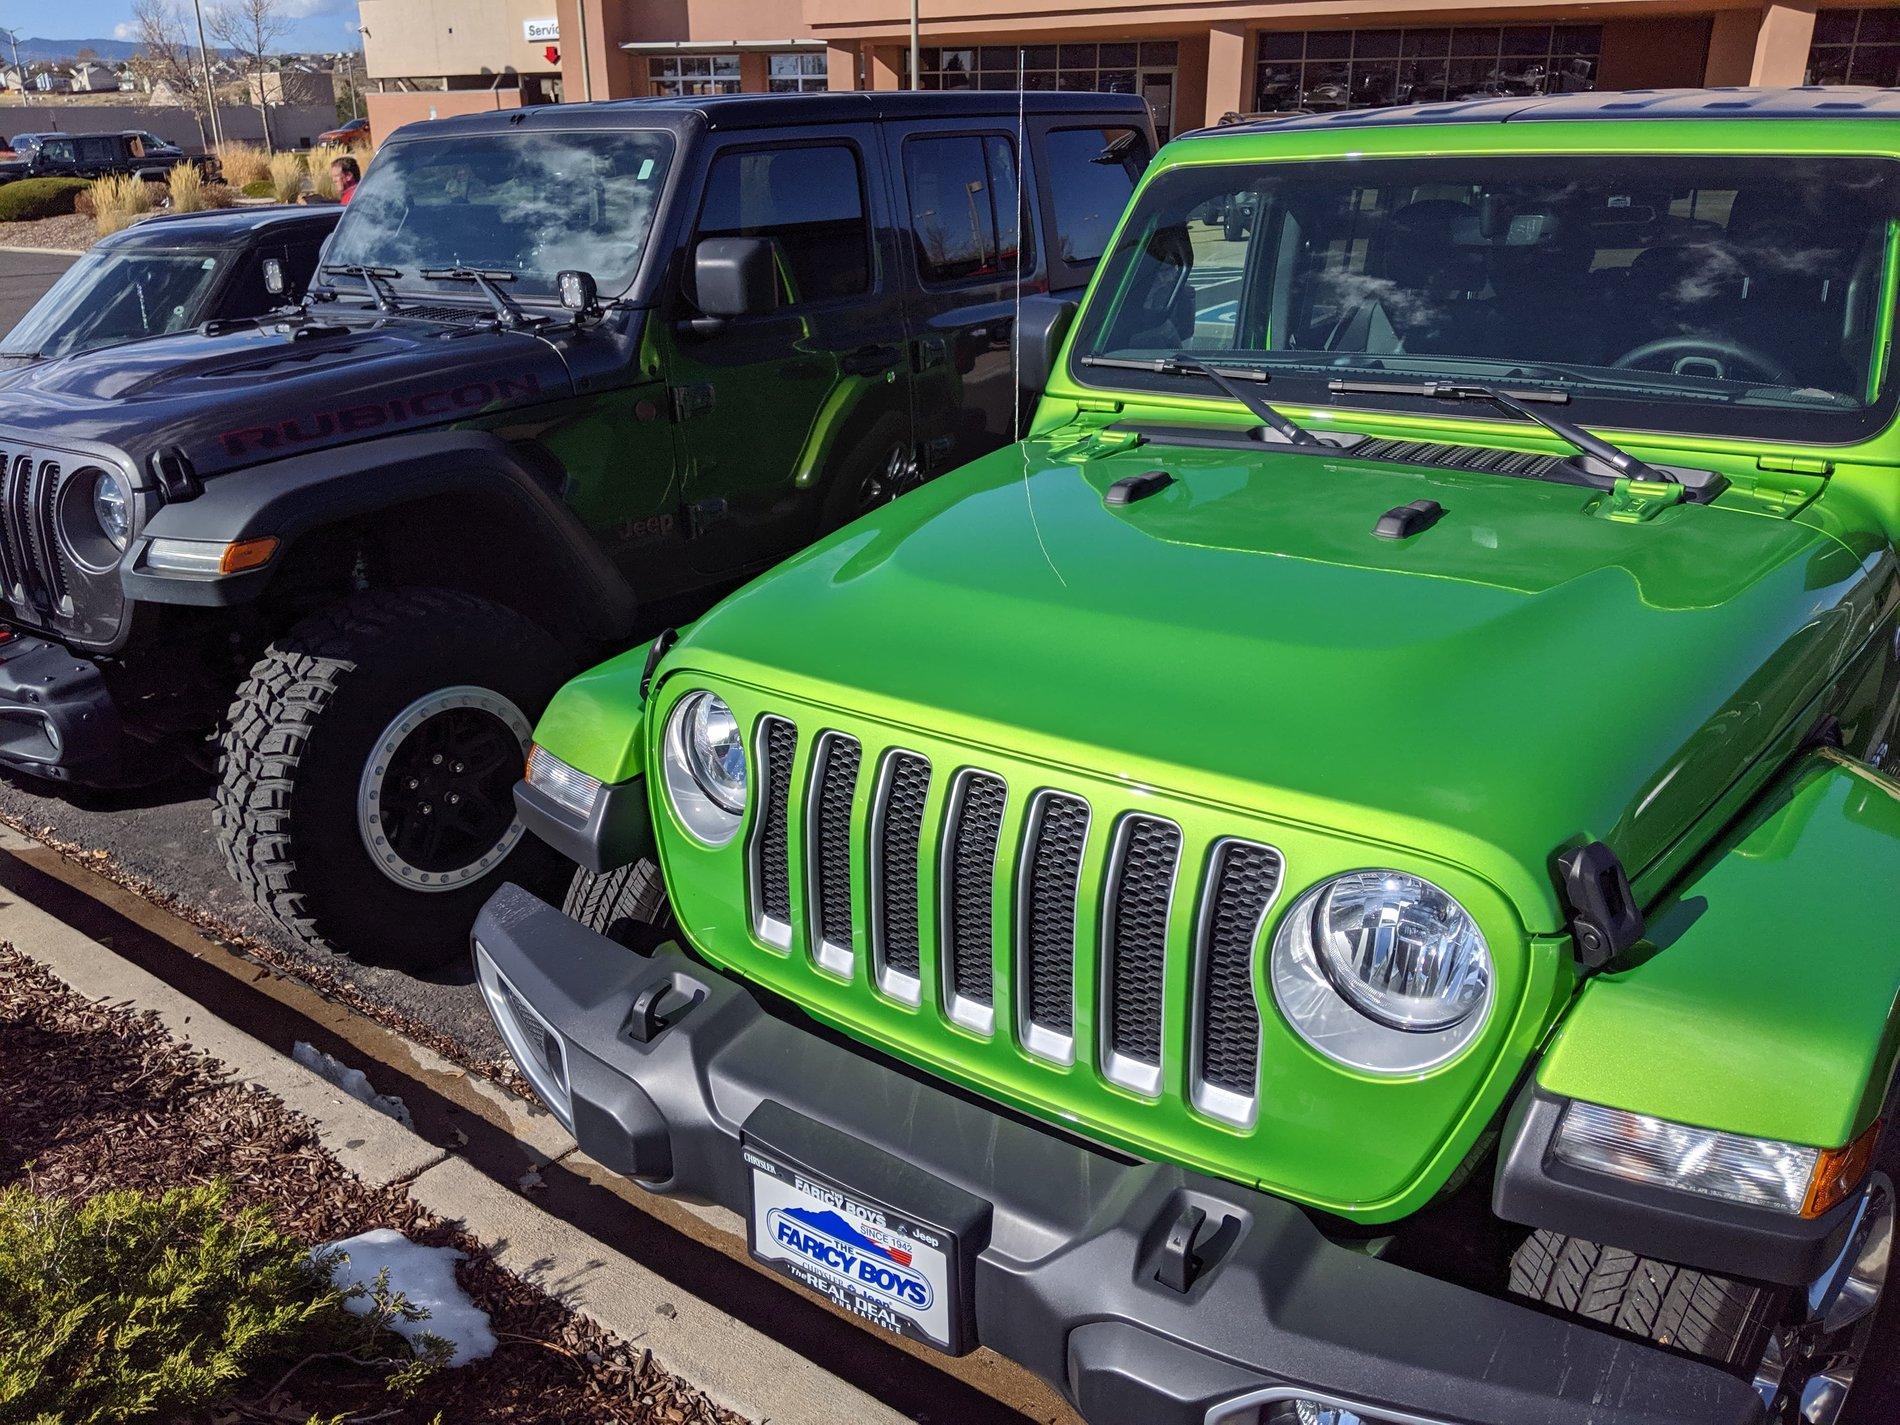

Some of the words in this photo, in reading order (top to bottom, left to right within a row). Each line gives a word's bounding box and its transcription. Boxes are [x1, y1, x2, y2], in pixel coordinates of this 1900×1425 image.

[217, 372, 543, 457] RUBICON
[618, 514, 673, 541] Jeep
[743, 1152, 777, 1175] CHRYSLER
[795, 1177, 843, 1208] FARICY
[845, 1201, 887, 1229] BOYS
[835, 1240, 855, 1256] THE
[860, 1226, 888, 1245] SINCE
[892, 1238, 913, 1252] 1942
[912, 1229, 939, 1248] Jeep
[777, 1221, 858, 1274] FARICY
[858, 1260, 926, 1305] BOYS
[806, 1271, 850, 1304] REAL
[831, 1296, 901, 1335] UNBEATABLE
